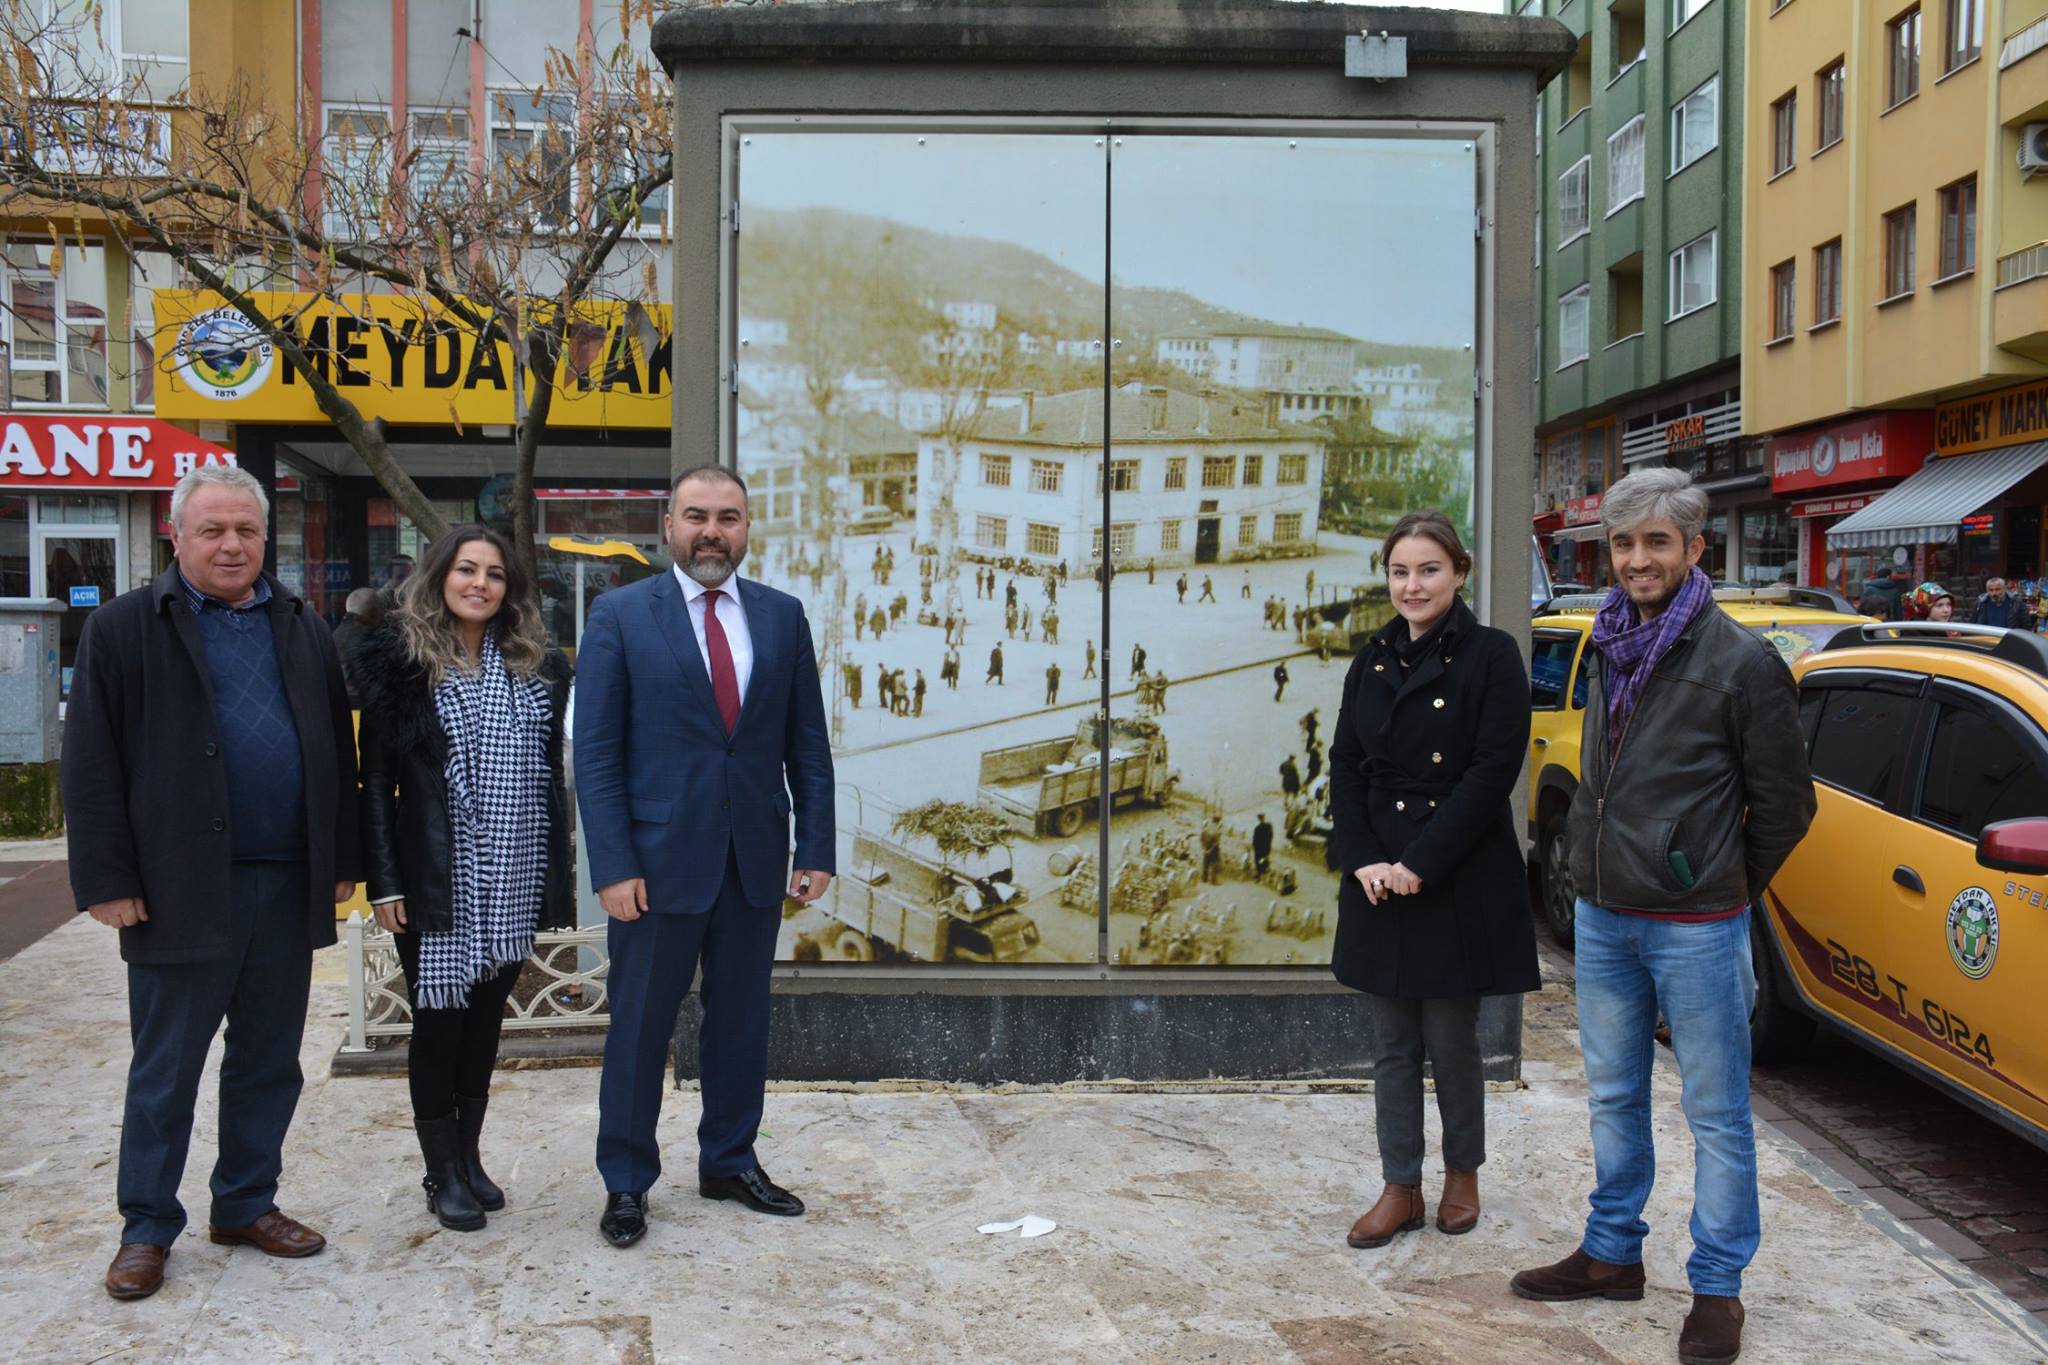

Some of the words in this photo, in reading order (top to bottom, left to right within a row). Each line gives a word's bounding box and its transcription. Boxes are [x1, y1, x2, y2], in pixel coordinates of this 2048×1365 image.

[281, 314, 542, 391] MEYDA
[0, 421, 155, 479] ANE
[1938, 399, 1993, 449] GÜNEY
[73, 591, 96, 602] AÇIK
[1827, 937, 1882, 1000] 28
[1886, 974, 1909, 1019] T
[1921, 998, 1997, 1069] 6124
